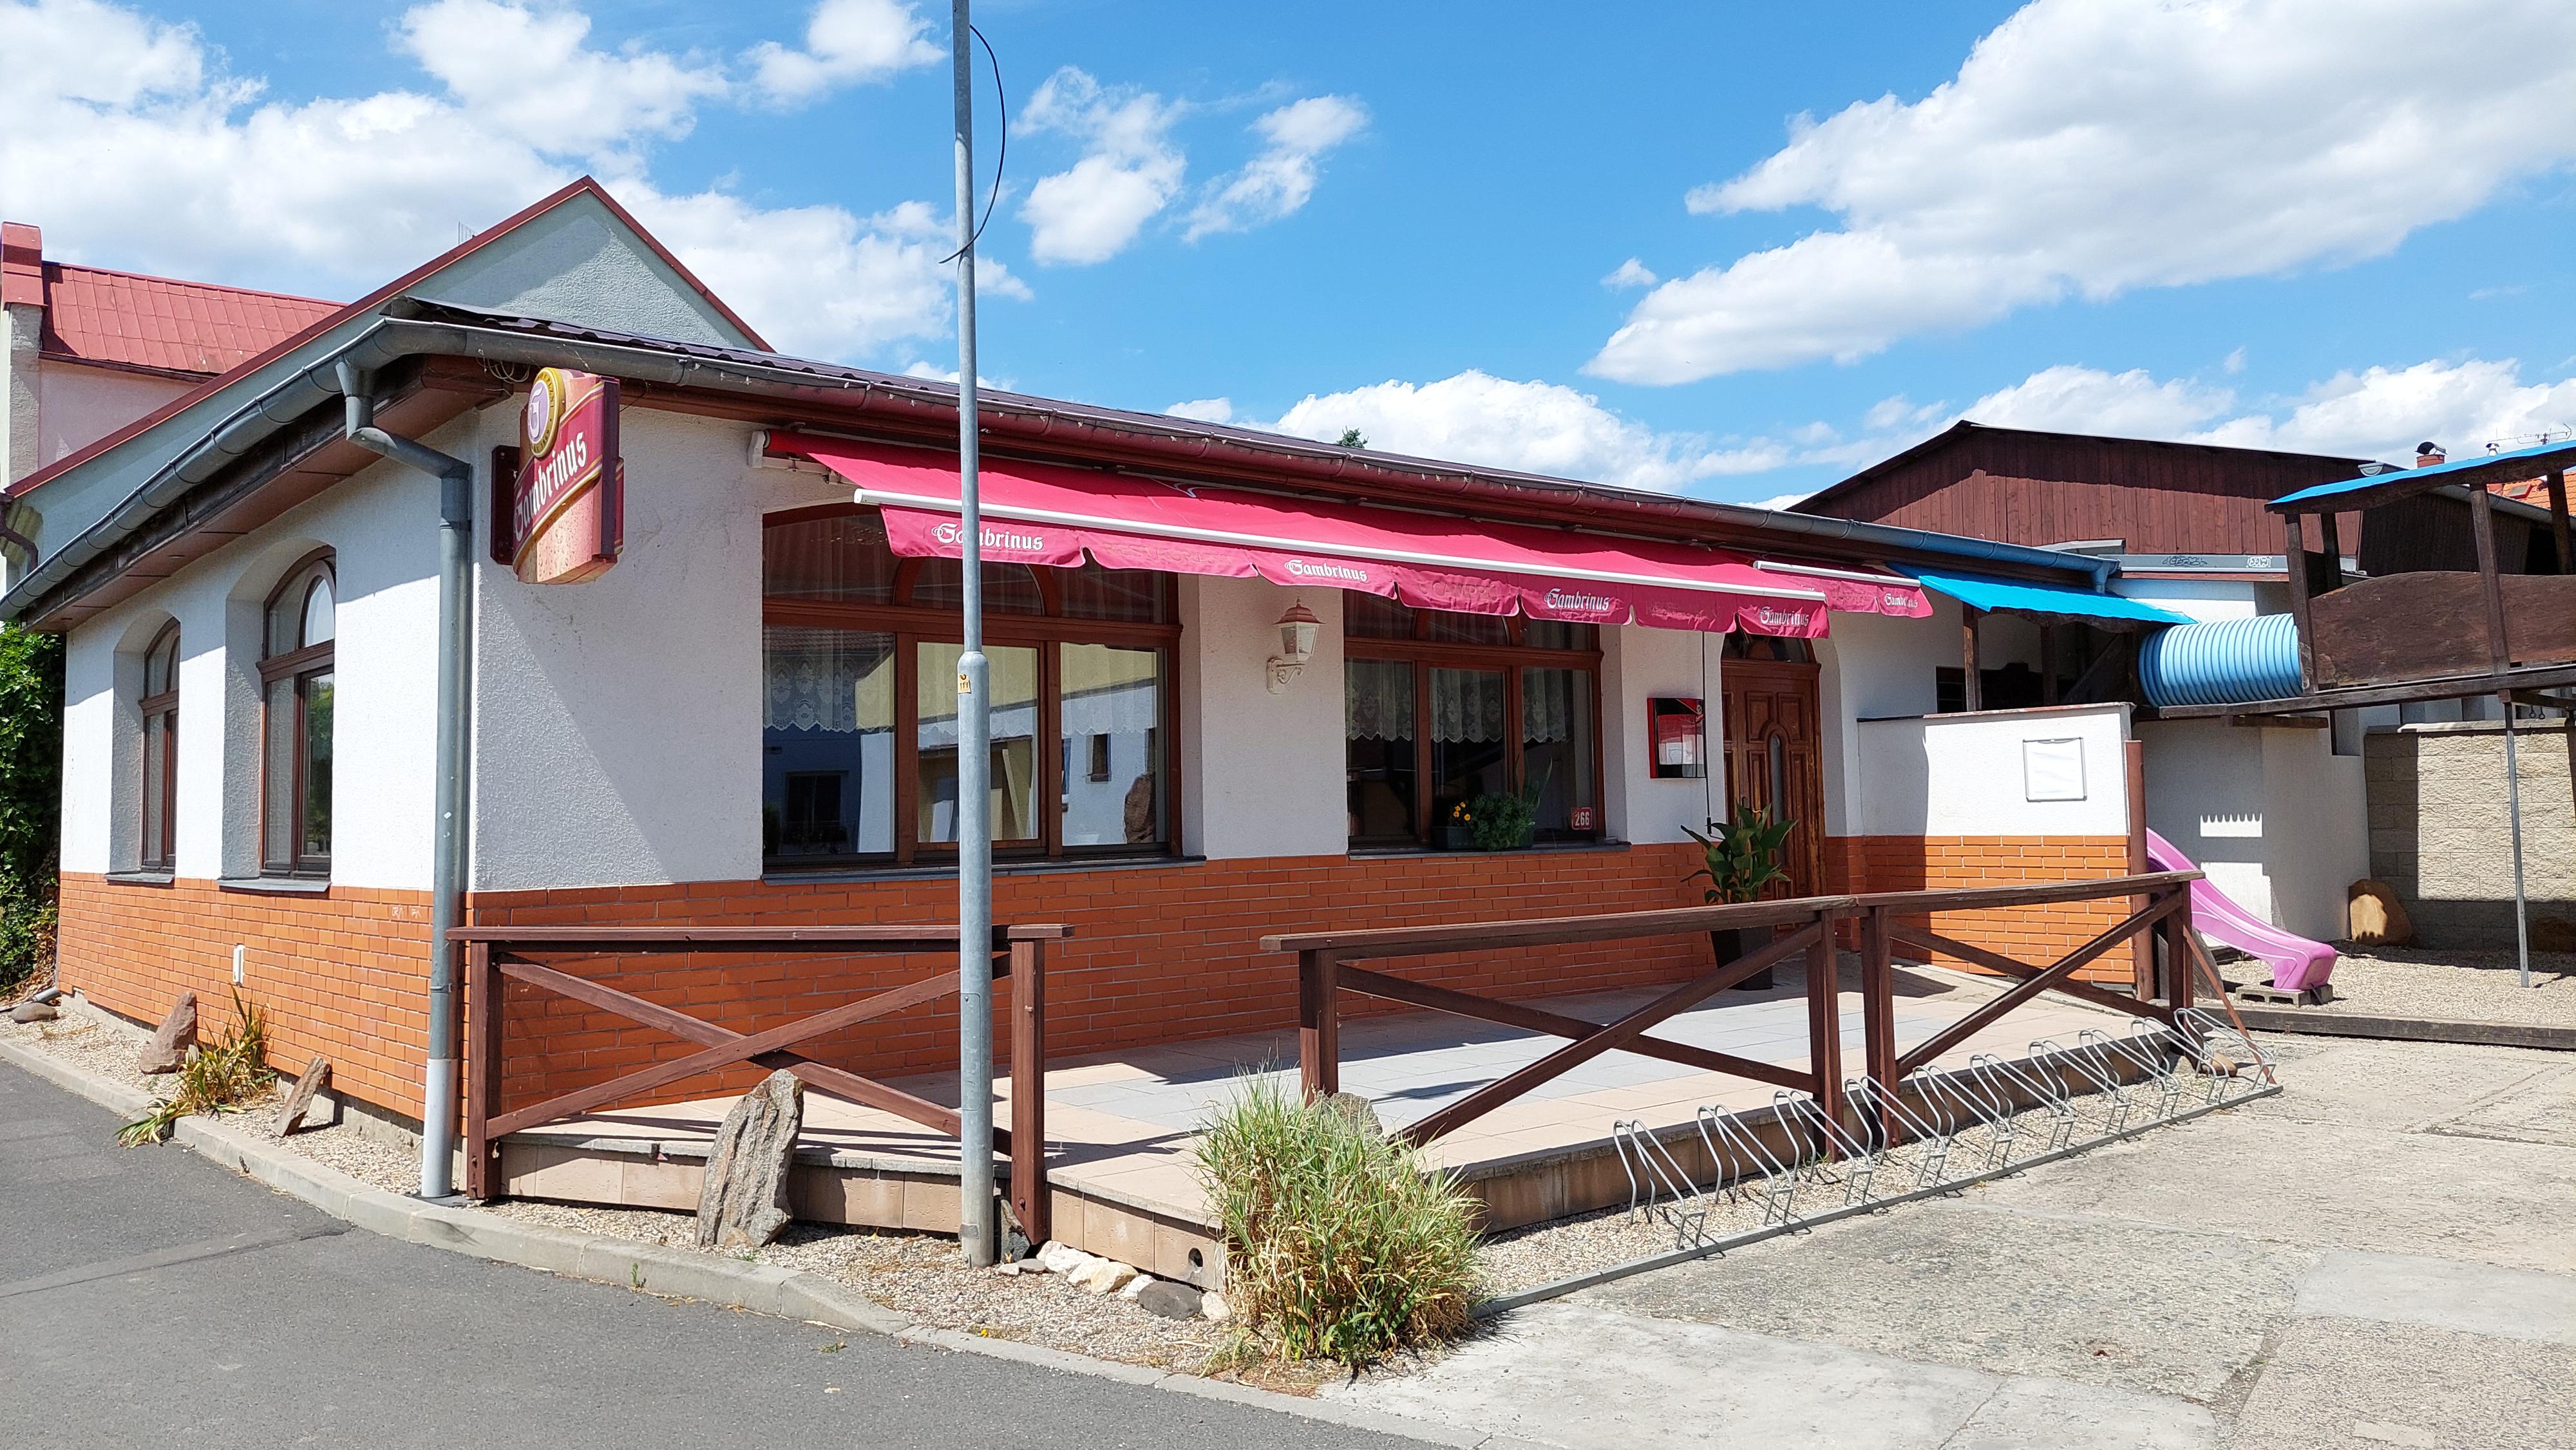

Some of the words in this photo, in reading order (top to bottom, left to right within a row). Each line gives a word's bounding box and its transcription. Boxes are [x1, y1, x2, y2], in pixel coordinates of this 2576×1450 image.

[515, 431, 587, 541] Gambrinus
[931, 522, 1043, 551] Gabrinus
[1284, 559, 1368, 582] Gambrinus
[1544, 588, 1610, 611] Gambrinus
[1759, 606, 1810, 627] Gambrinus
[1575, 811, 1590, 826] 266
